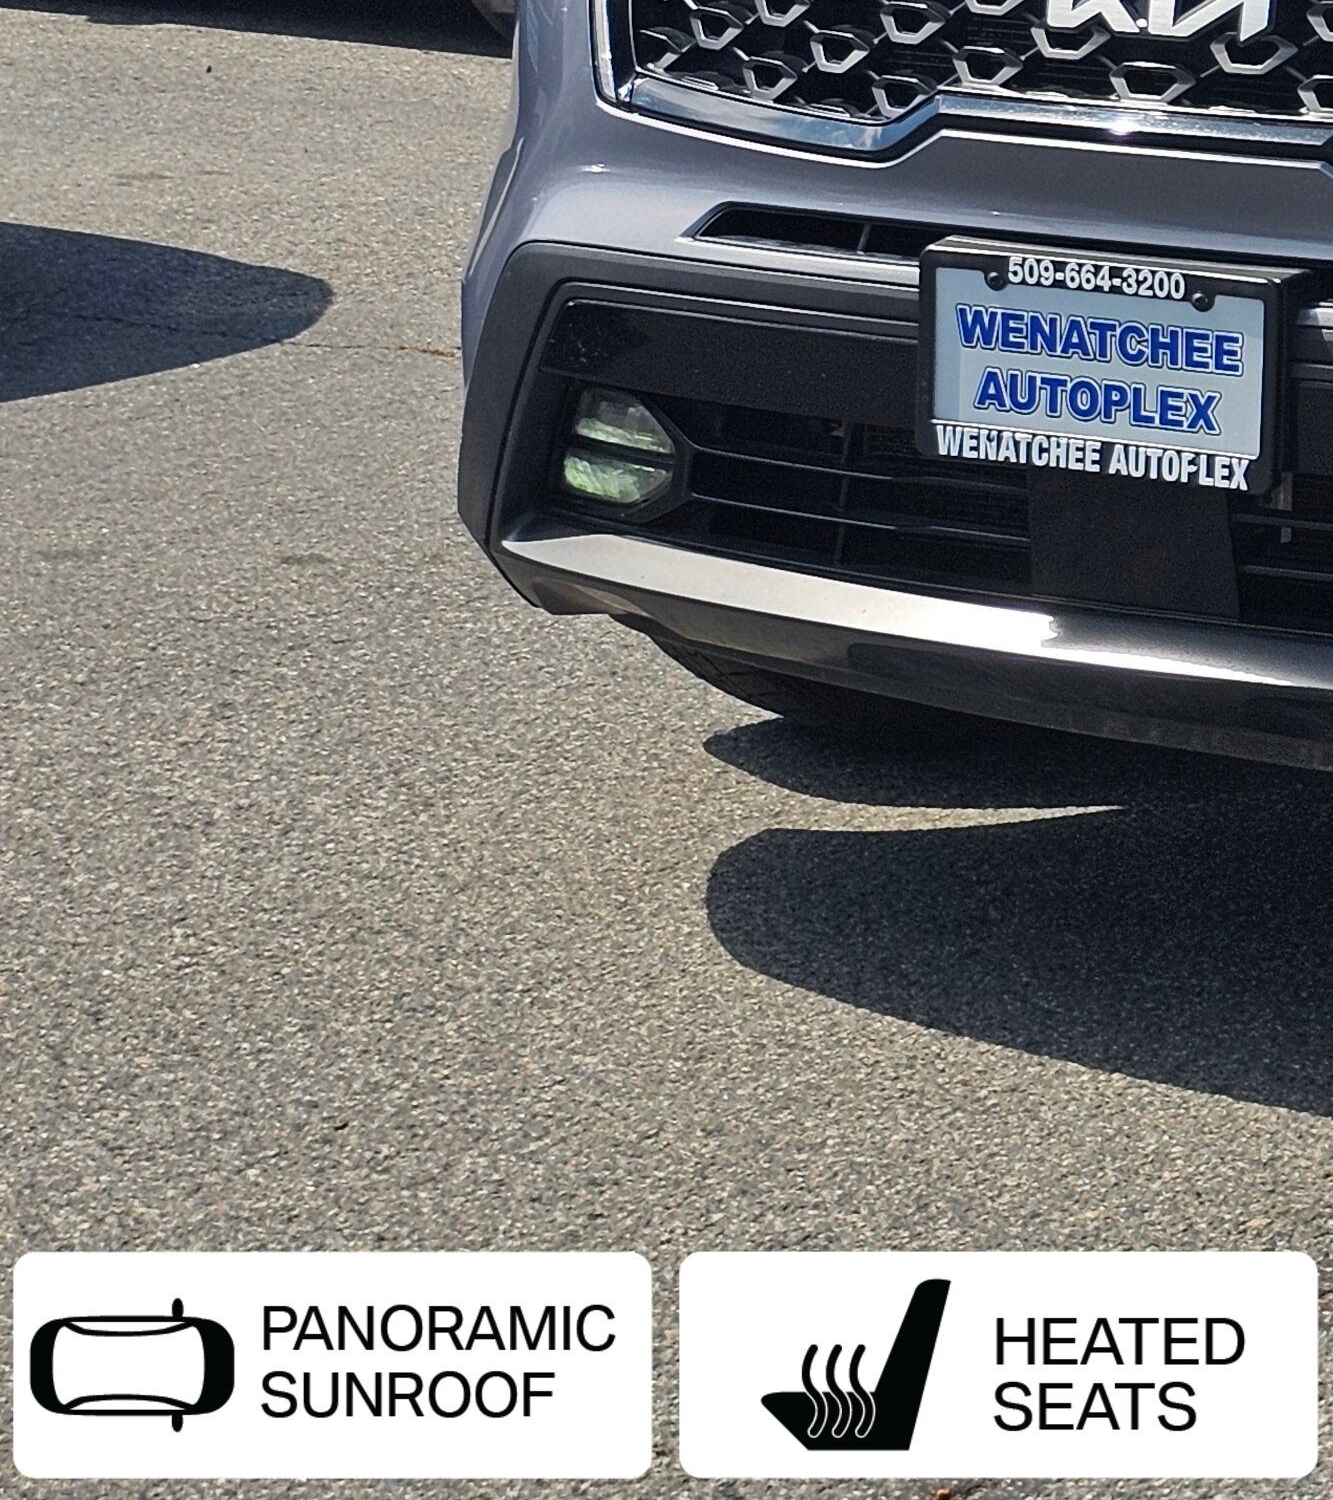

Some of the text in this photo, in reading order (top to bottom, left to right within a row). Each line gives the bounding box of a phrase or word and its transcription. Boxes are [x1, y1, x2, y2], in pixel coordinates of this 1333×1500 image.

[1008, 257, 1185, 299] 509-664-3200
[956, 304, 1244, 376] WENATCHEE
[974, 367, 1221, 435] AUTOPLEX
[936, 425, 1102, 473] WENATCHEE
